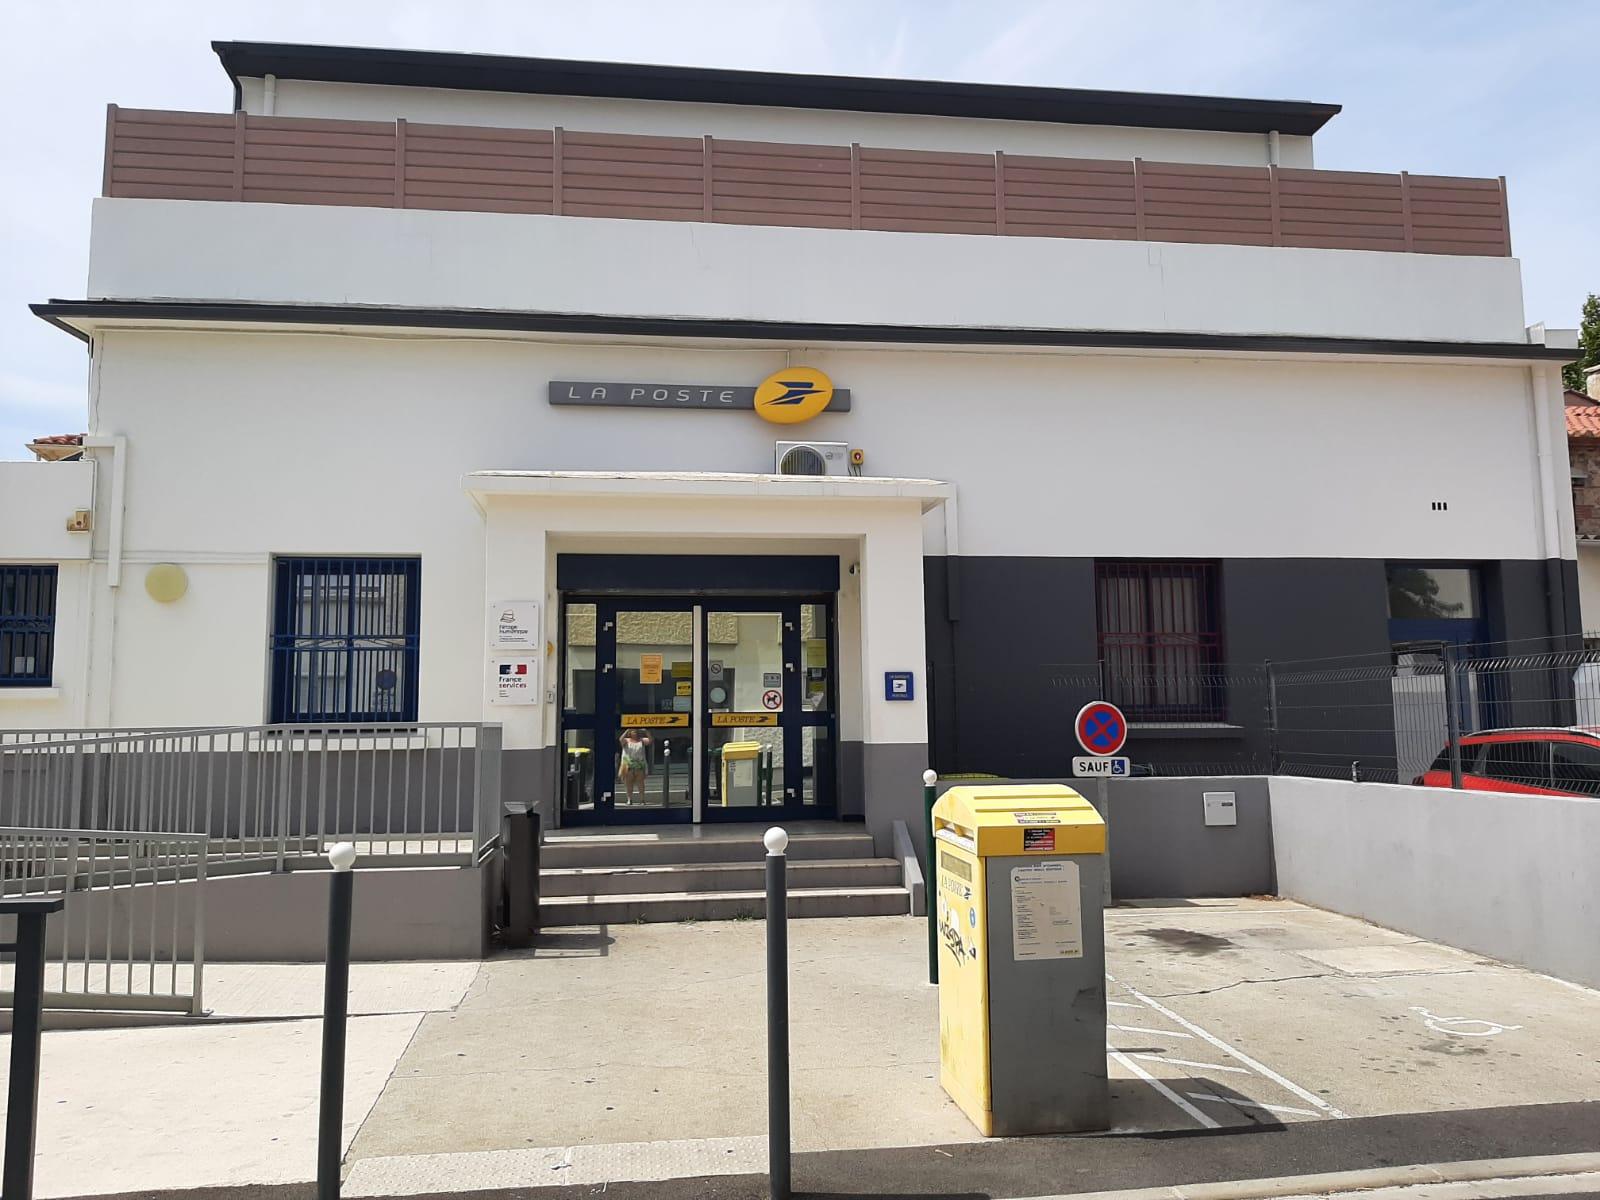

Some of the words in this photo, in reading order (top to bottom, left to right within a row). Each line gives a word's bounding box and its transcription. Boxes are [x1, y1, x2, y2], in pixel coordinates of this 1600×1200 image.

[568, 386, 608, 400] LA
[630, 388, 735, 403] POSTE
[626, 716, 638, 725] LA
[640, 716, 666, 725] POSTE
[717, 715, 728, 724] LA
[730, 715, 756, 724] POSTE
[1079, 761, 1109, 773] SAUF
